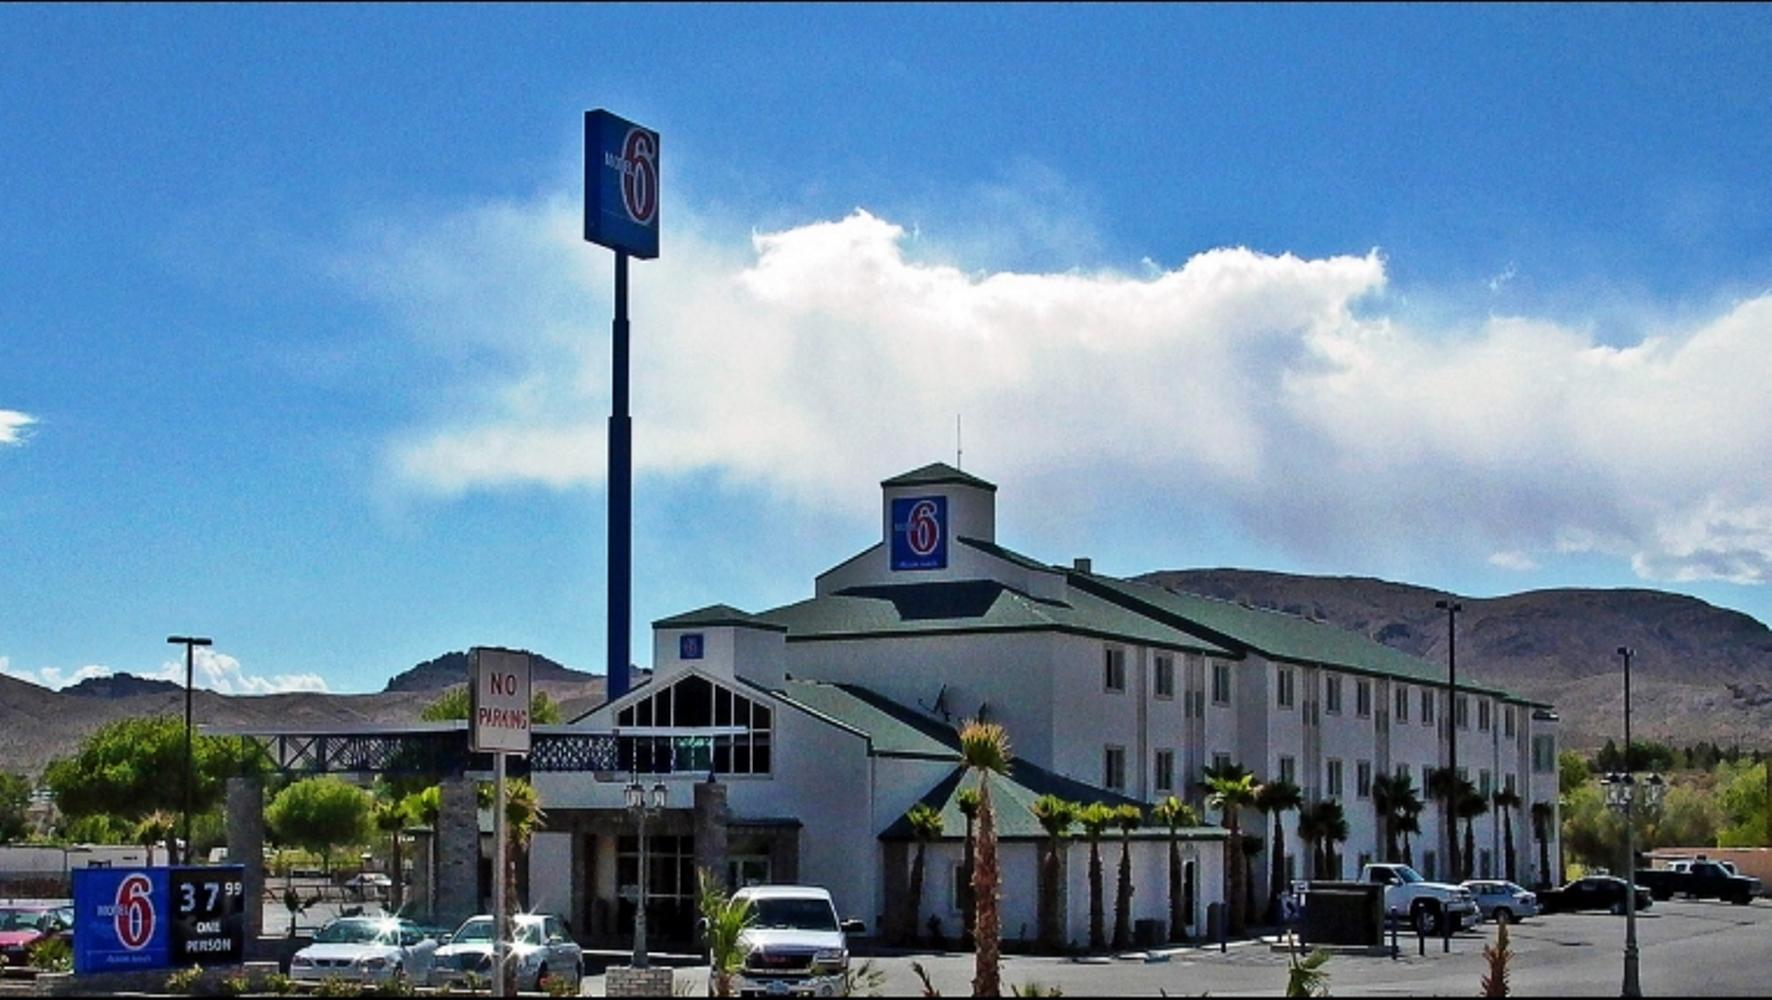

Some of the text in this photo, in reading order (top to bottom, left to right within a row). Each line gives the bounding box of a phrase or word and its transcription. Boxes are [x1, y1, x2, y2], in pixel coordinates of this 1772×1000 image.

[621, 127, 658, 225] 6
[907, 500, 940, 555] 6
[490, 672, 517, 696] NO
[479, 707, 528, 730] PARKING
[115, 872, 156, 950] 6
[197, 921, 221, 933] ONE
[186, 938, 231, 953] PERSON
